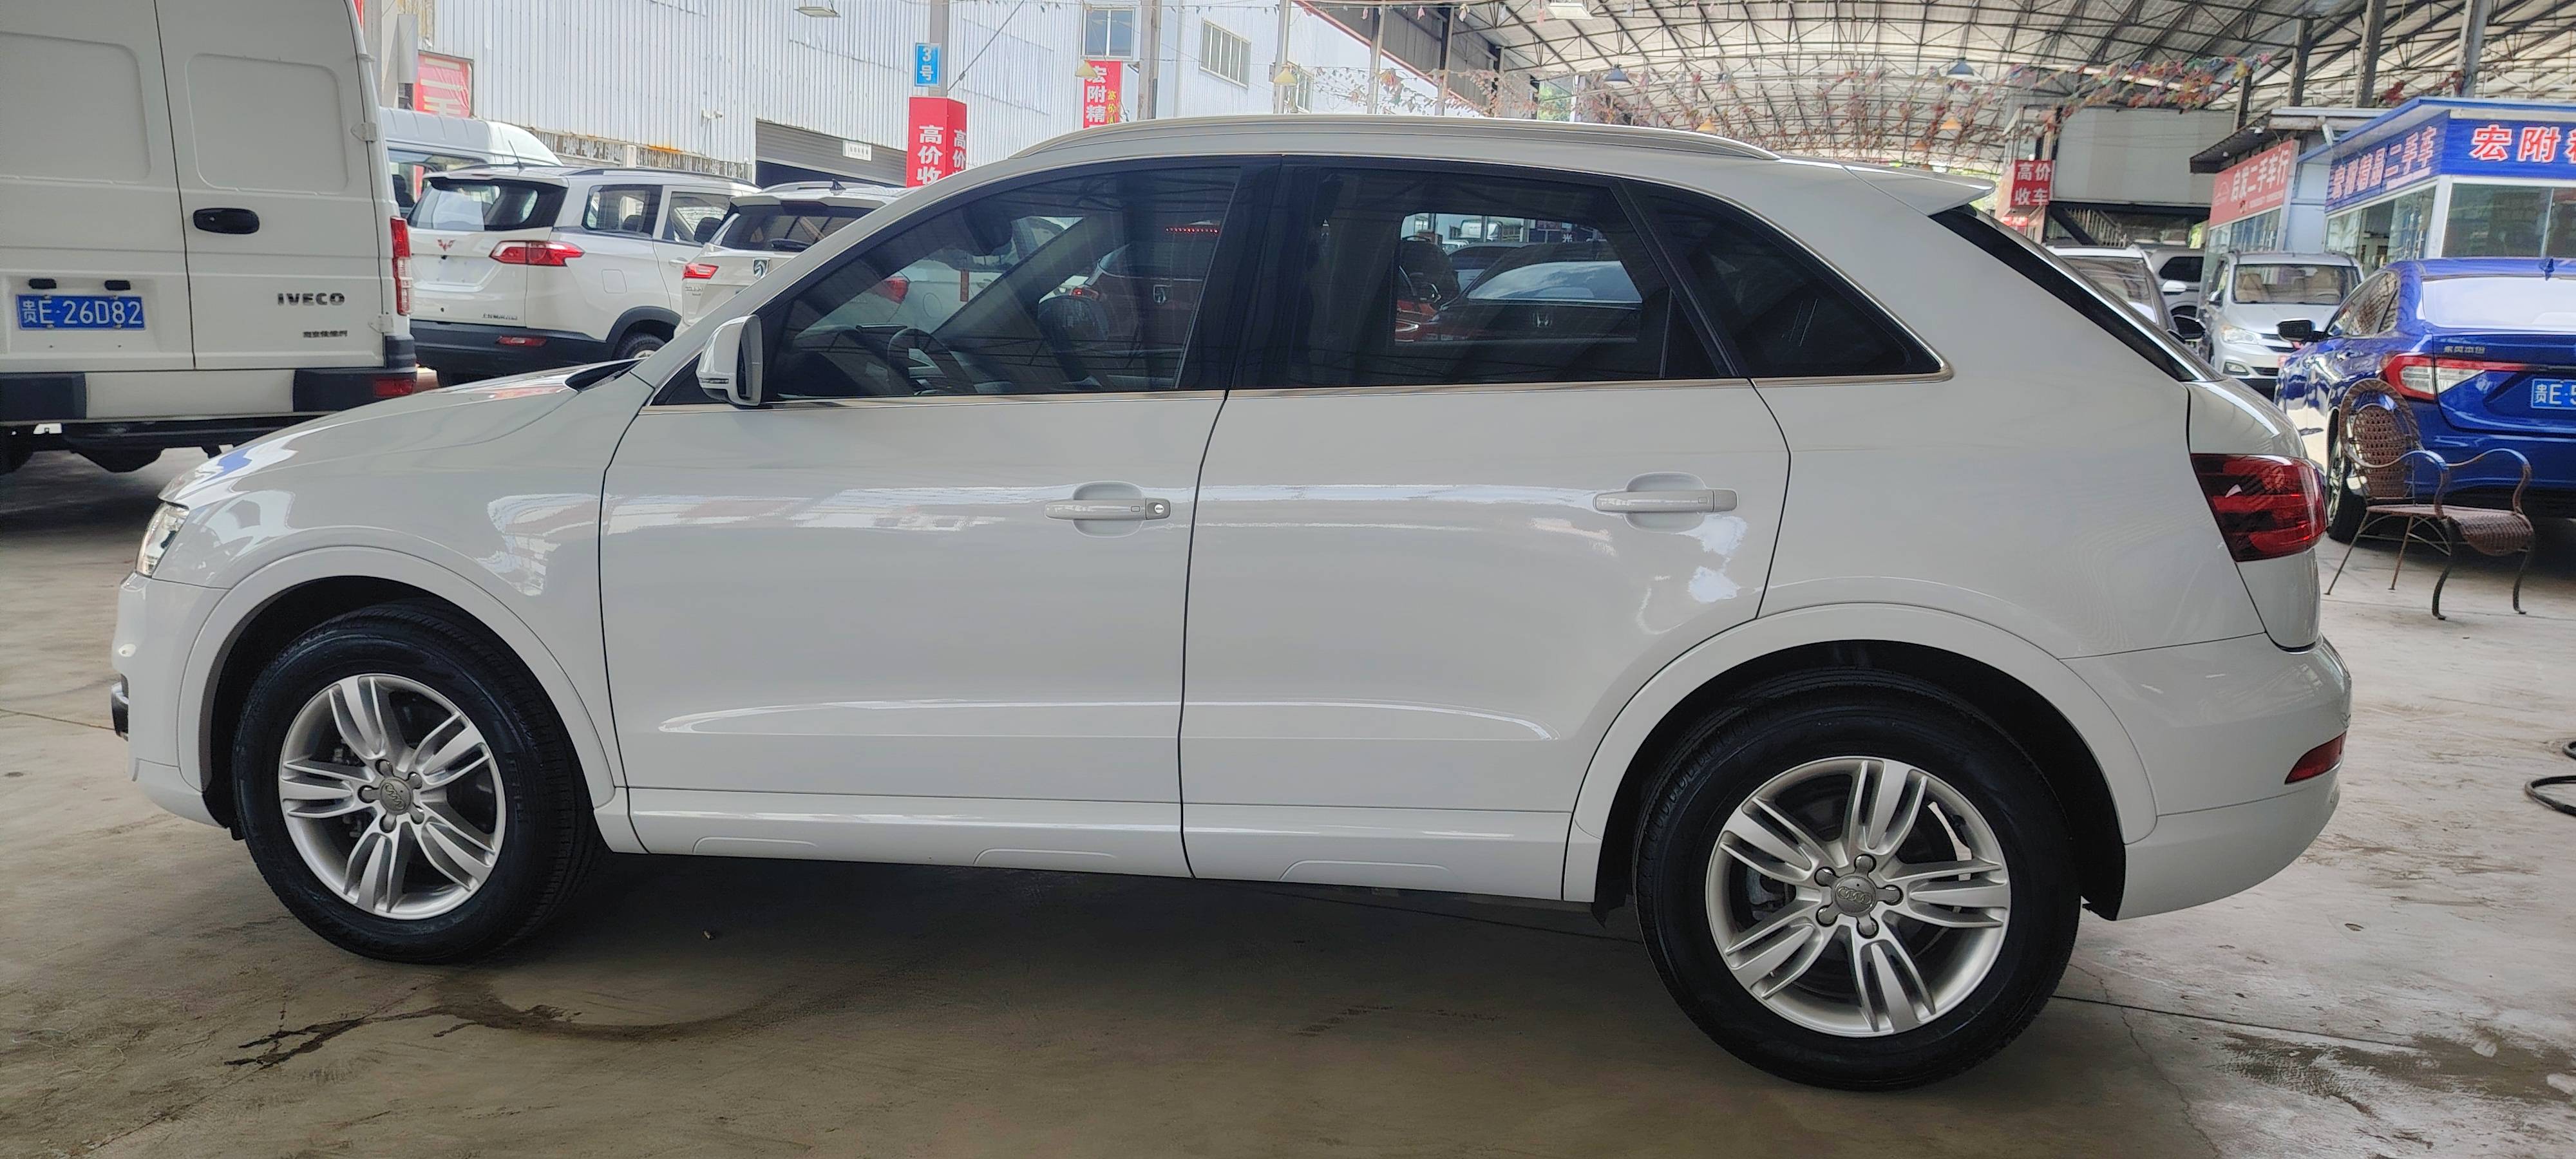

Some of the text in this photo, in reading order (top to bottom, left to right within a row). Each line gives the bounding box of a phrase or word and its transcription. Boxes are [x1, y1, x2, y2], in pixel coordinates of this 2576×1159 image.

[920, 47, 934, 81] 3号
[2017, 162, 2051, 181] 高价
[2014, 187, 2048, 205] 收车
[278, 292, 345, 305] IVECO
